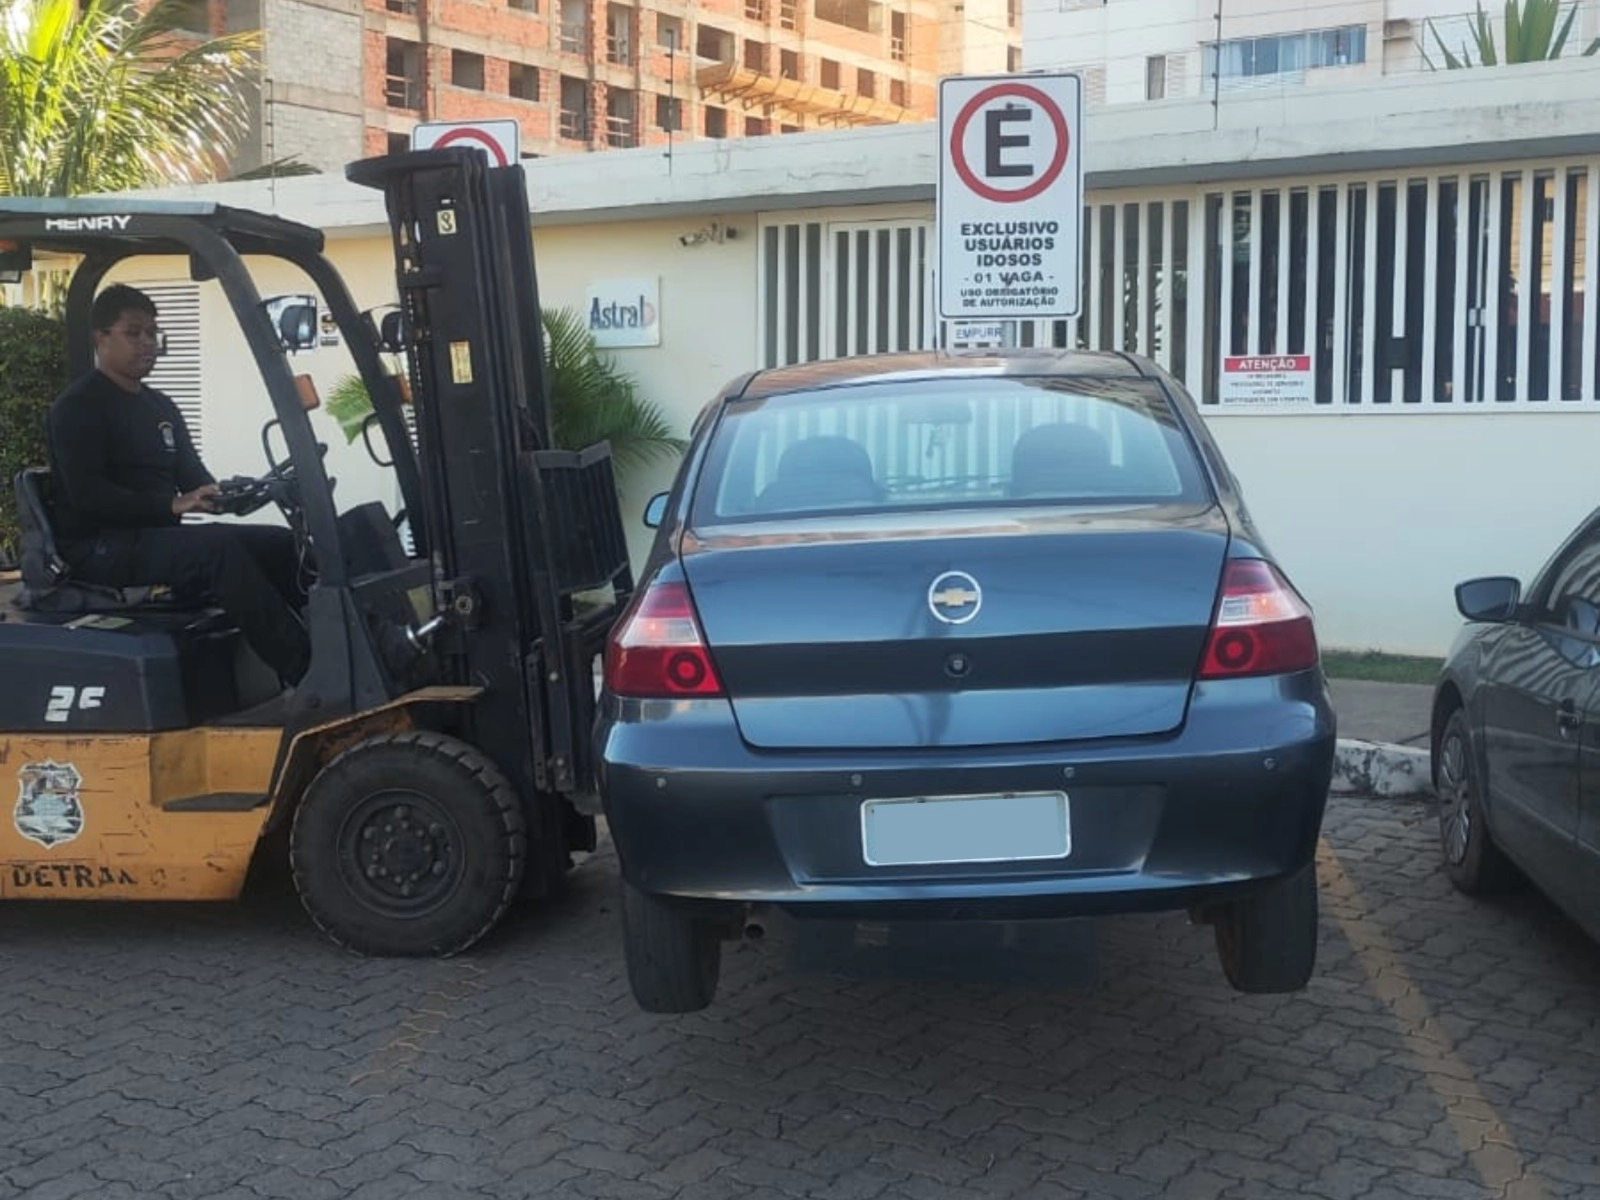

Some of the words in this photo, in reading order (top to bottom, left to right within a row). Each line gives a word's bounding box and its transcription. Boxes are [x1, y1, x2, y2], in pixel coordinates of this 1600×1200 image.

[985, 109, 1033, 176] E
[45, 215, 131, 230] HENRY
[961, 222, 1058, 235] EXCLUSIVO
[965, 236, 1054, 251] USUÁRIOS
[977, 253, 1041, 266] IDOSOS
[974, 272, 991, 283] 01
[999, 271, 1043, 282] VAGA
[980, 295, 1056, 309] AUTORIZAÇÃO
[1239, 357, 1296, 371] ATENÇÃO
